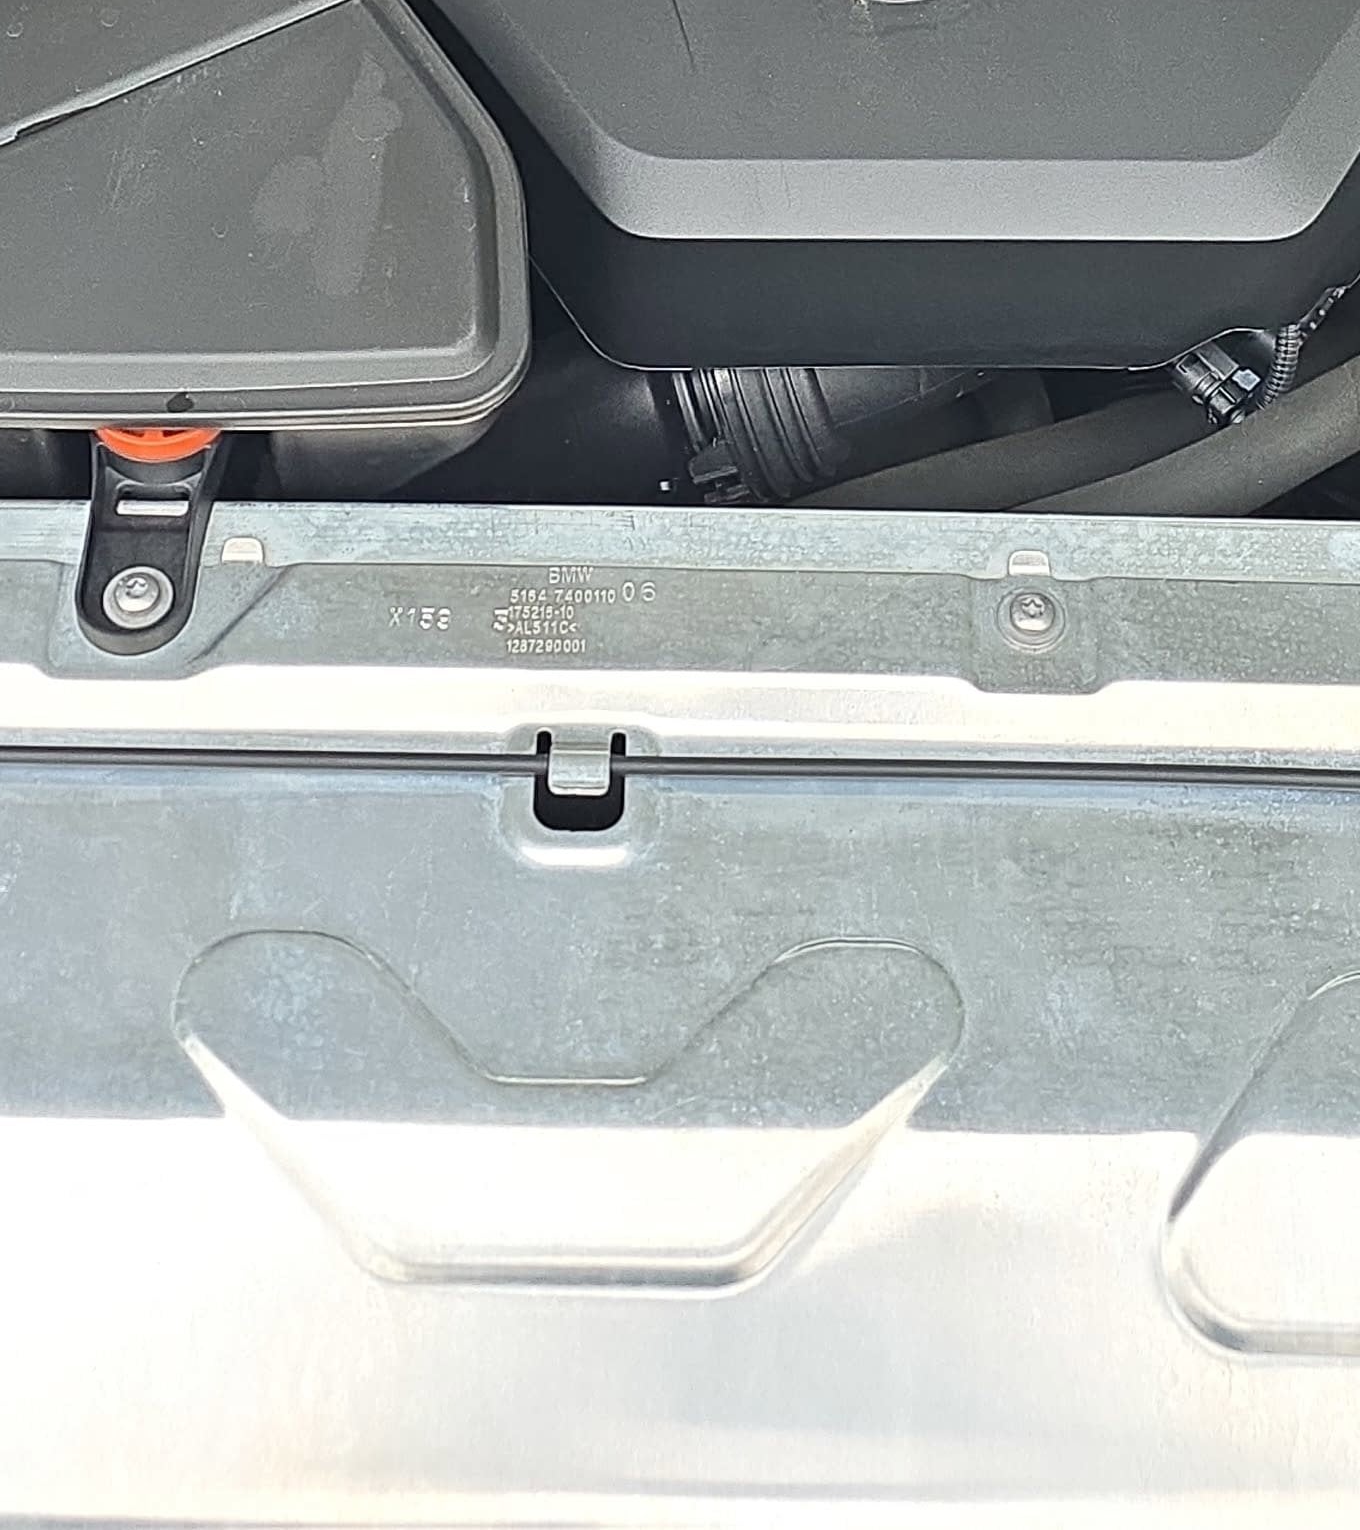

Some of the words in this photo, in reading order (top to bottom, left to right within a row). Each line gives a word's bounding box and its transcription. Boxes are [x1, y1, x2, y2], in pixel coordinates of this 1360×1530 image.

[549, 566, 594, 584] BMW
[510, 588, 547, 603] 5164
[554, 588, 616, 604] 7400110
